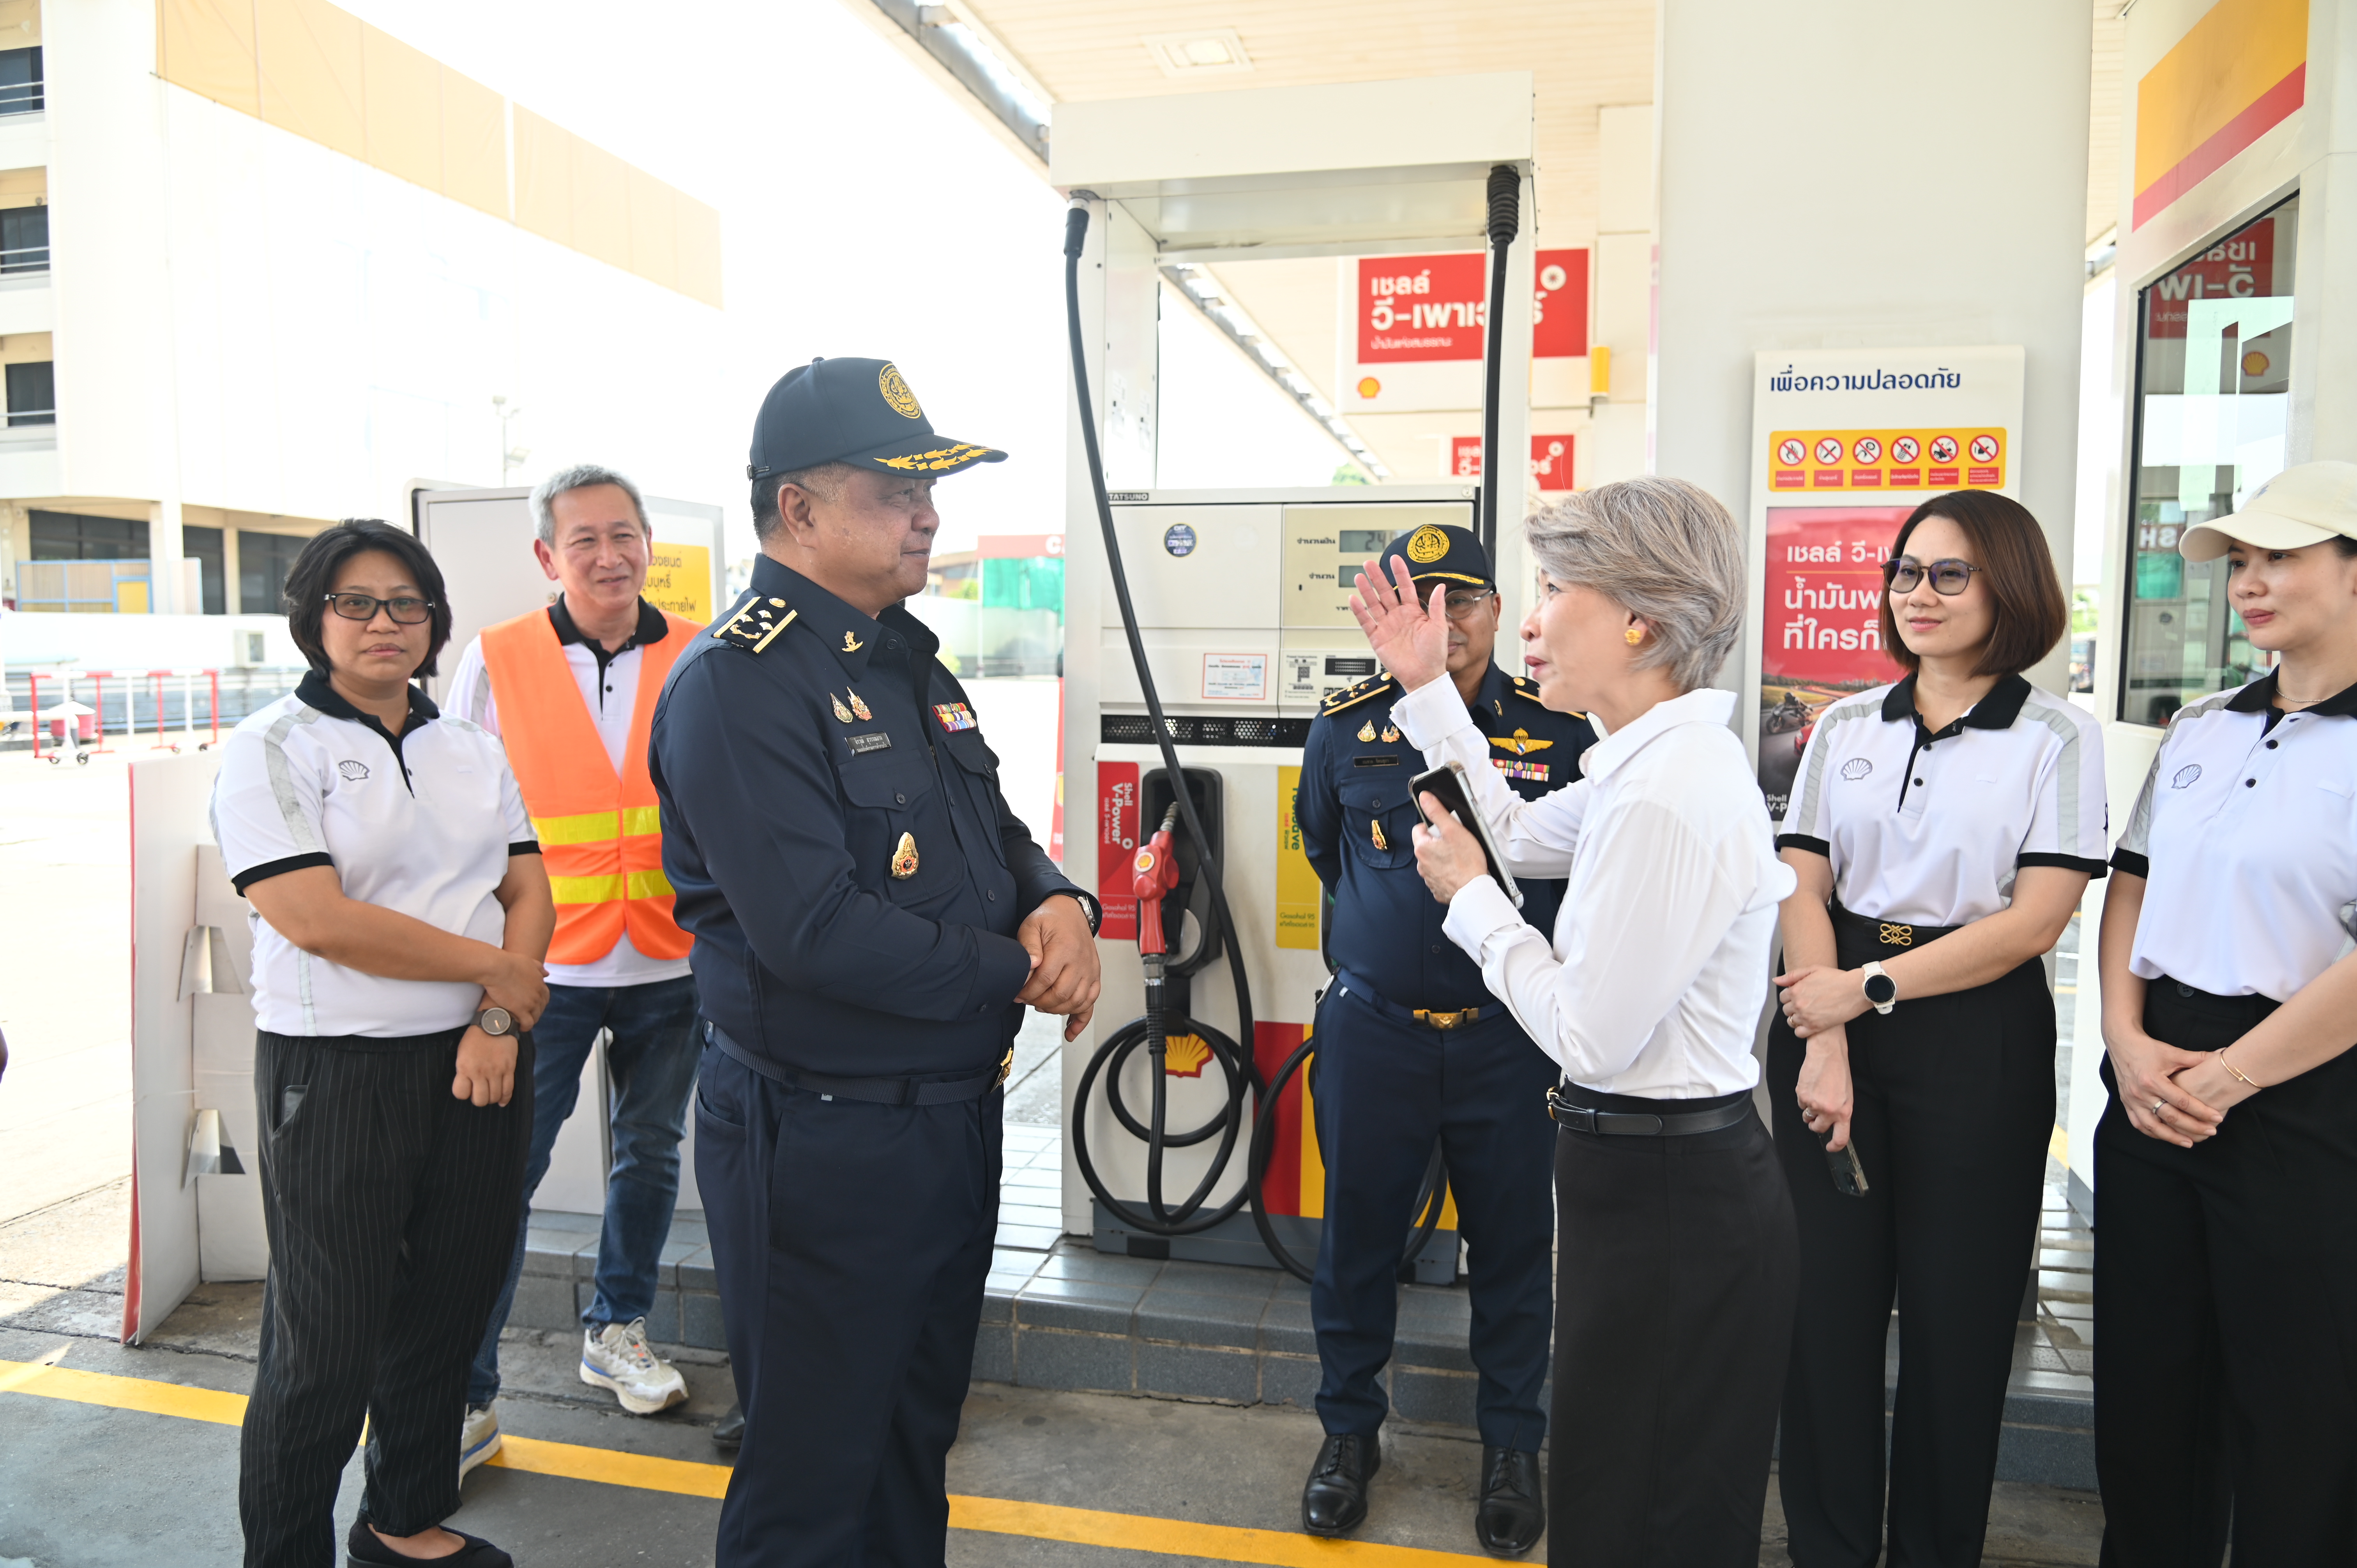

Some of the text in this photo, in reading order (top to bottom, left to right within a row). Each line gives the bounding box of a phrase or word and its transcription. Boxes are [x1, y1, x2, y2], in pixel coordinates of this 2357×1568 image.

[1371, 268, 1431, 296] เชลล์
[1770, 364, 1961, 391] เพื่อความปลอดภัย
[1109, 493, 1148, 501] TATSUNO
[1787, 540, 1842, 562] เชลล์
[1783, 613, 1880, 650] ที่ใครก็
[1124, 782, 1133, 806] Shell
[1766, 793, 1787, 802] Shell
[1111, 782, 1124, 844] V-Power
